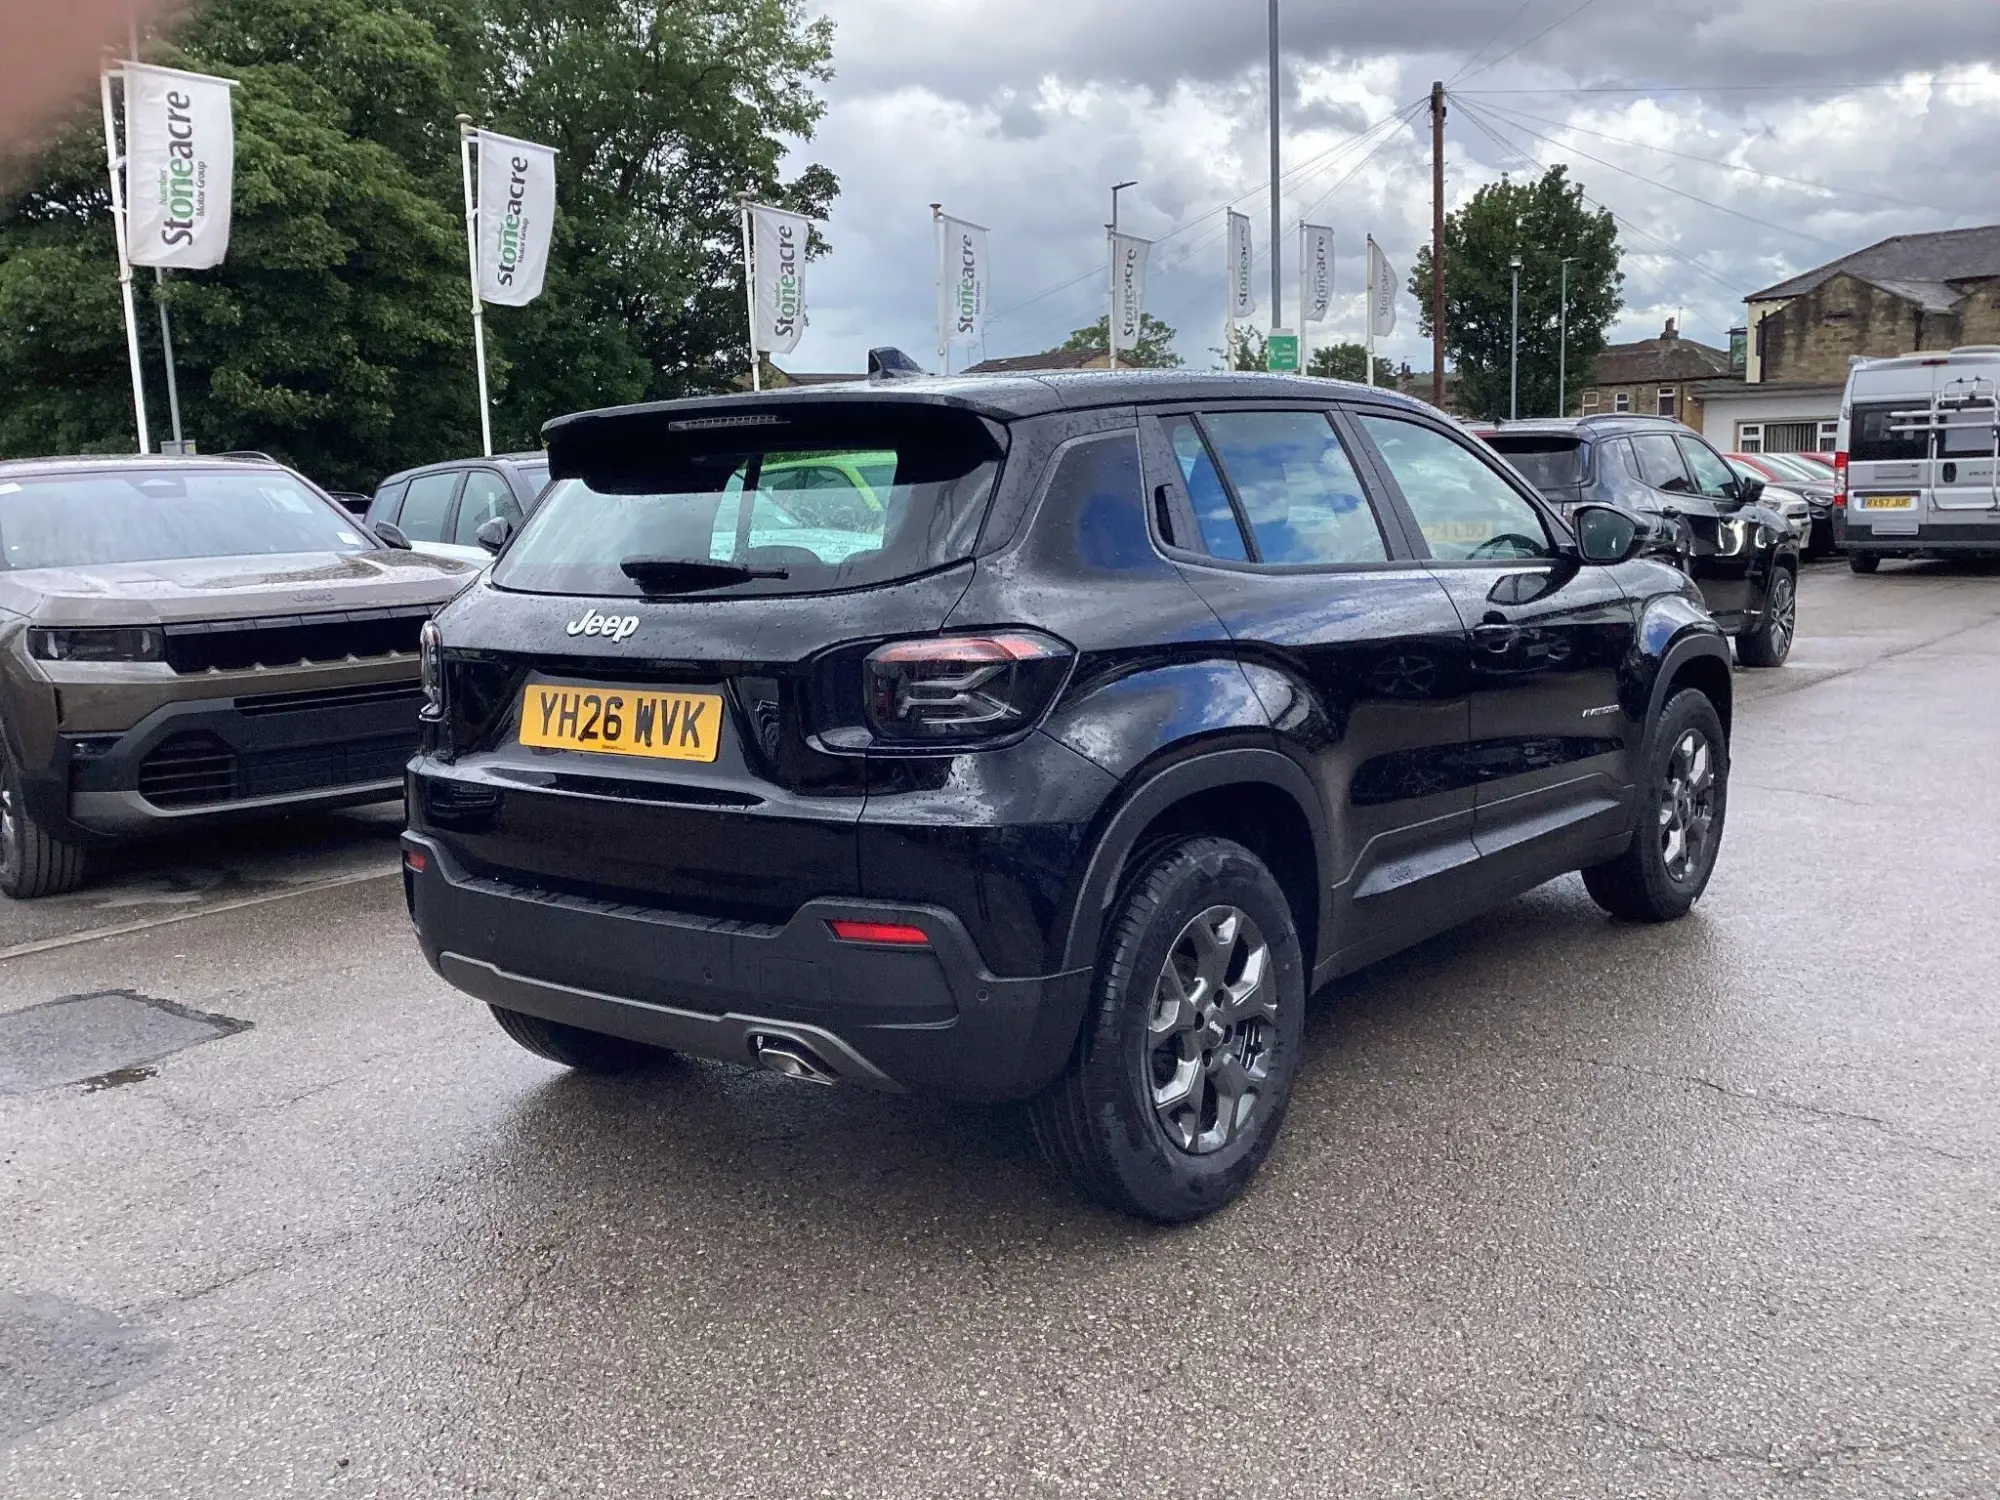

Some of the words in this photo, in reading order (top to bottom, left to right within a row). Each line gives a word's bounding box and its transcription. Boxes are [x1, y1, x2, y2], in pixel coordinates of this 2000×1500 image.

[161, 90, 194, 246] Stoneacre
[195, 160, 208, 184] Group
[195, 185, 205, 217] Motor
[497, 156, 528, 286] Stoneacre
[520, 218, 529, 241] Group
[774, 225, 796, 337] Stoneacre
[957, 234, 975, 334] Stoneacre
[1123, 248, 1137, 337] Stoneacre
[1315, 235, 1328, 311] Stoneacre
[1866, 497, 1890, 508] RX57
[1892, 496, 1910, 507] JUF
[566, 609, 640, 644] Jeep
[540, 691, 624, 743] YH26
[634, 697, 706, 749] WVK
